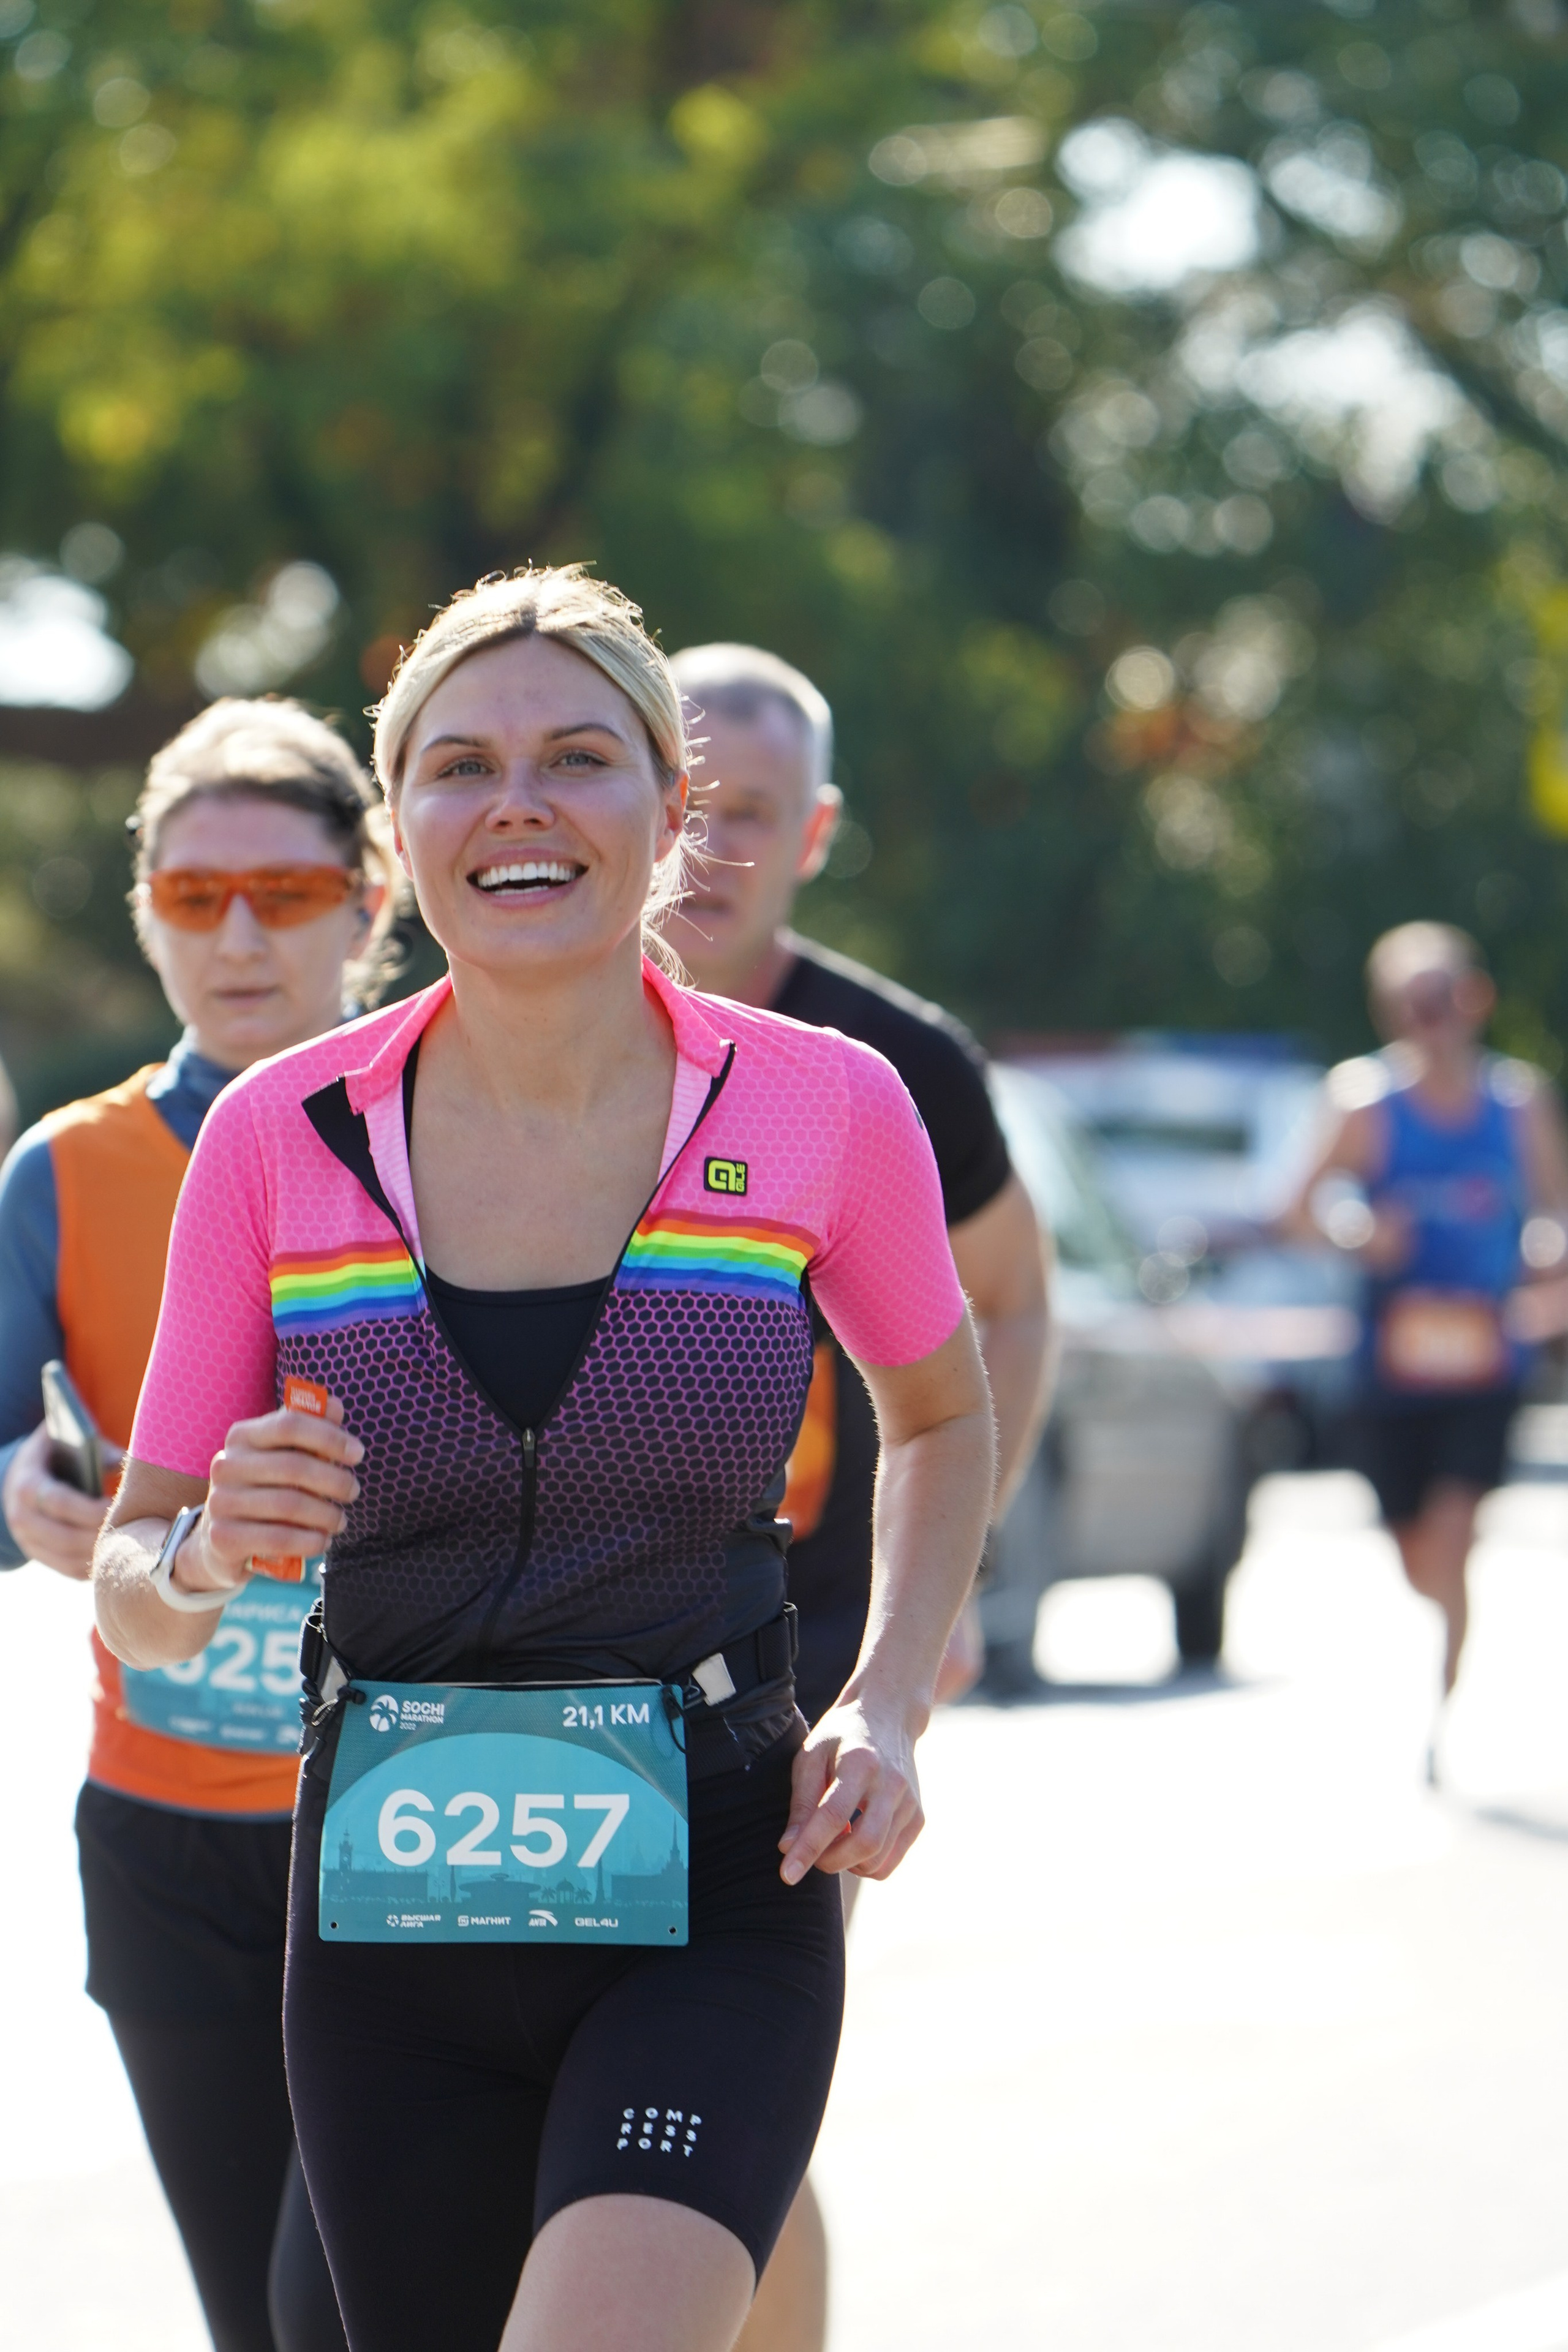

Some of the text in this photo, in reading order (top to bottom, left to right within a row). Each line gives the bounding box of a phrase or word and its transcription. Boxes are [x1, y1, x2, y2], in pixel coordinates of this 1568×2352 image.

[402, 1700, 445, 1716] SOCHI
[563, 1702, 650, 1730] 21,1 KM
[400, 1713, 443, 1724] MARATHON
[377, 1789, 630, 1869] 6257
[470, 1916, 511, 1925] МАГНИТ
